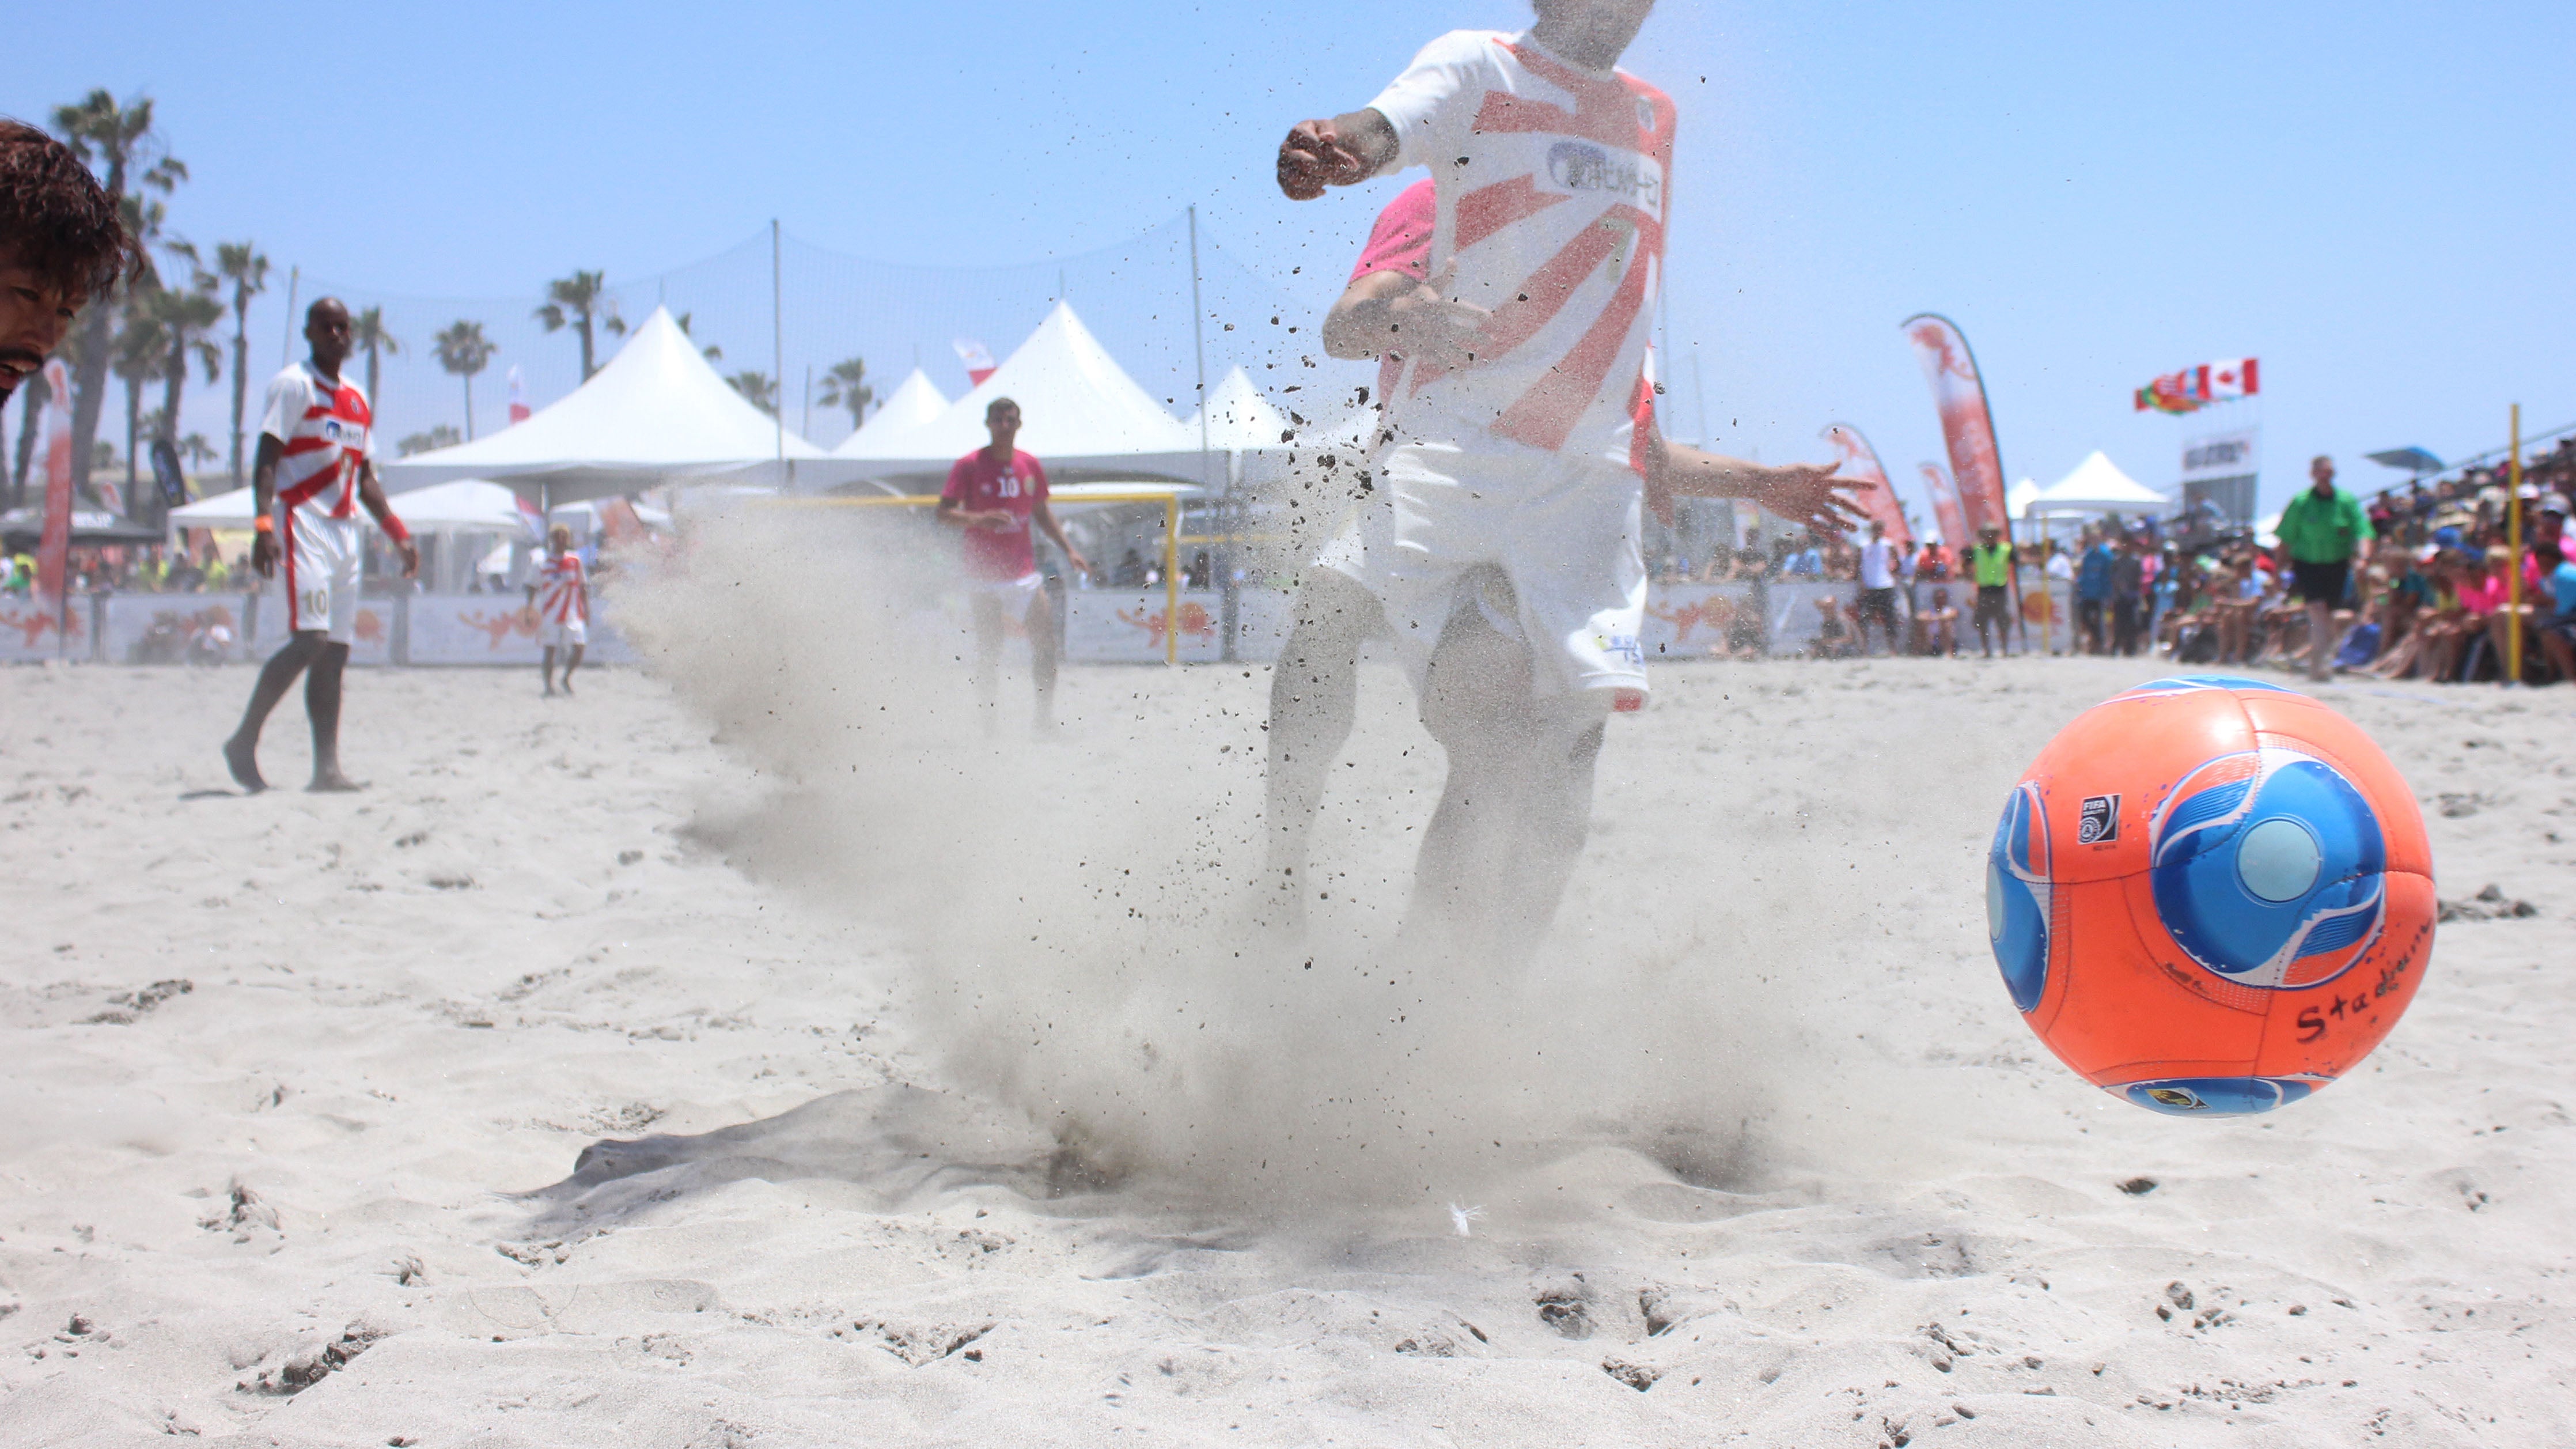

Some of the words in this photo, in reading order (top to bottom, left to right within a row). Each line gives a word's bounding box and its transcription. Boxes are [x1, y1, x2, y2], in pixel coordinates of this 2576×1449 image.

[997, 476, 1020, 498] 10
[304, 589, 328, 615] 10
[2082, 799, 2107, 811] FIFA
